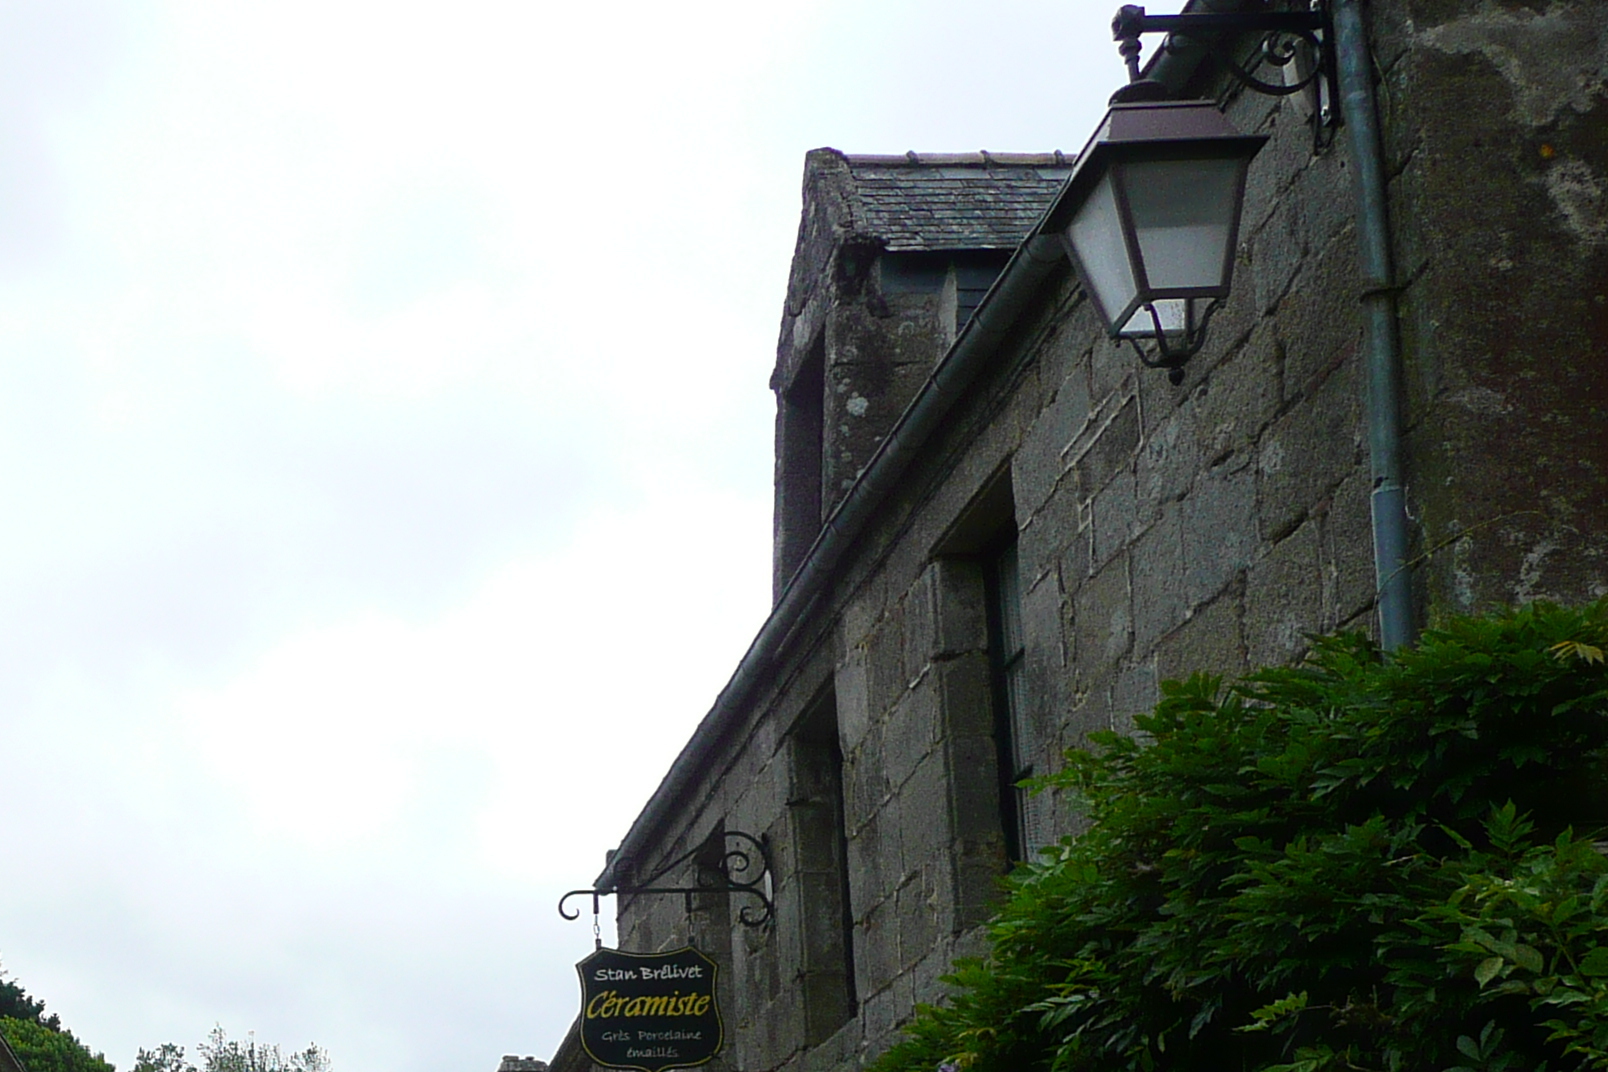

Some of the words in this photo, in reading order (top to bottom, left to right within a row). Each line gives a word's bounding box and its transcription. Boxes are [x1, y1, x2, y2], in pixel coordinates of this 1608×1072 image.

[594, 968, 637, 981] Stan
[639, 964, 703, 980] Brélivet
[586, 990, 711, 1019] Céramiste
[601, 1029, 631, 1042] Grès
[638, 1029, 702, 1041] Porcelaine
[626, 1045, 679, 1058] émaillés
